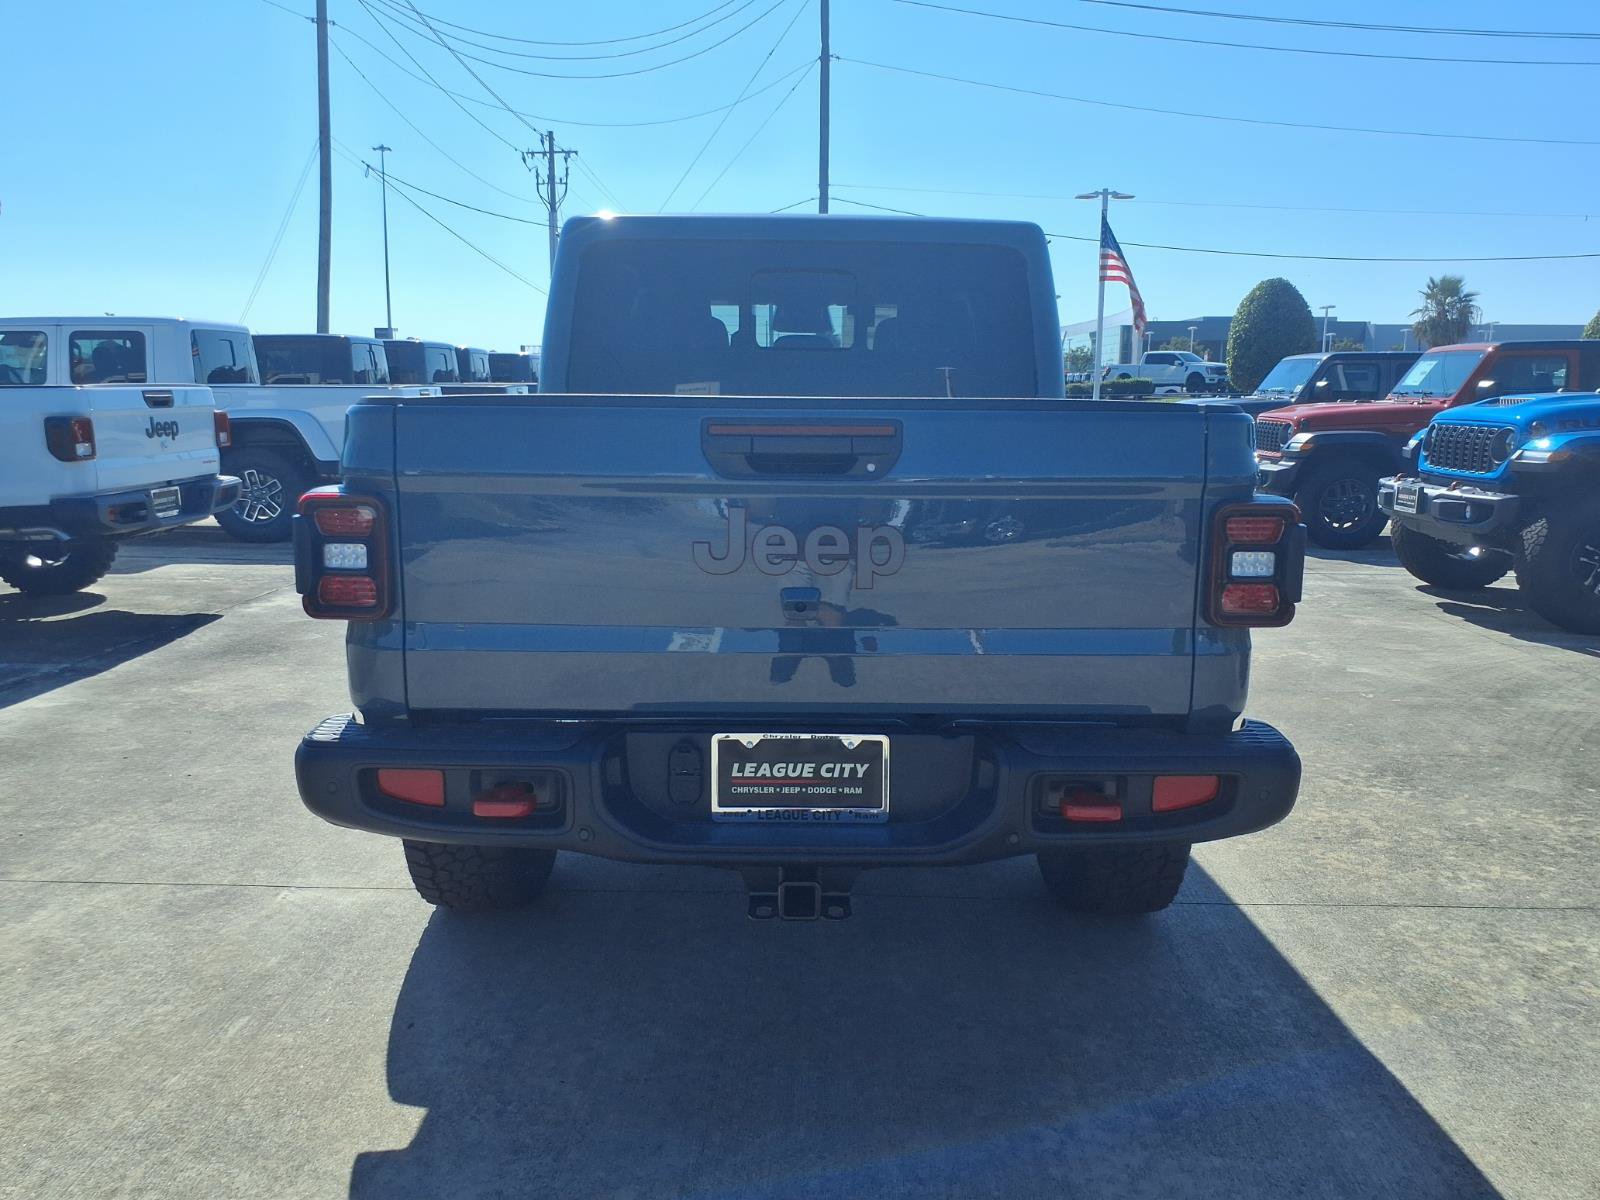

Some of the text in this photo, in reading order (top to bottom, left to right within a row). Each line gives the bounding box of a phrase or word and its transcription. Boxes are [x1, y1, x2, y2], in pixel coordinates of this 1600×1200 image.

[145, 416, 179, 440] Jeep
[692, 507, 905, 589] Jeep
[731, 762, 870, 778] LEAGUE CITY
[731, 786, 863, 794] CHRYSLER JEEP DODGE RAM
[757, 809, 809, 821] LEAGUE
[811, 810, 842, 821] CITY
